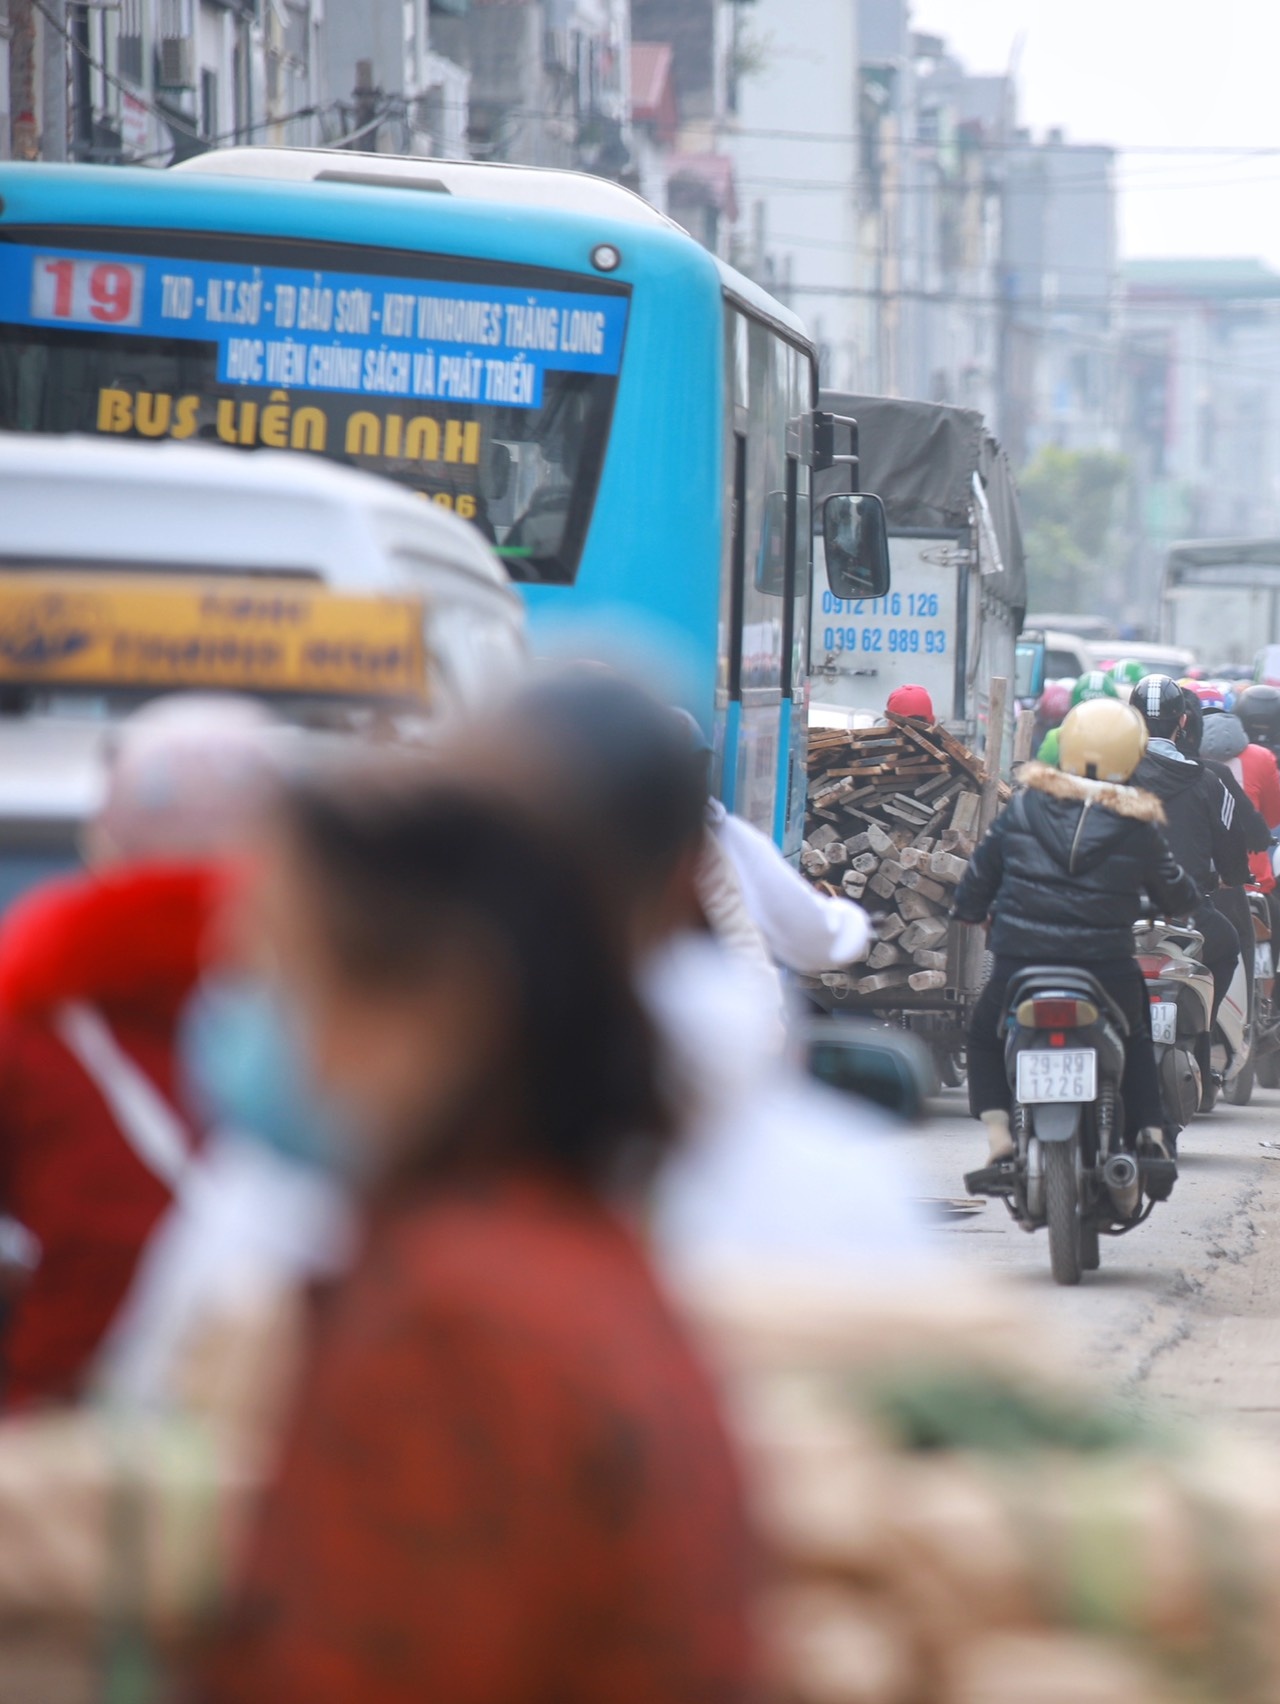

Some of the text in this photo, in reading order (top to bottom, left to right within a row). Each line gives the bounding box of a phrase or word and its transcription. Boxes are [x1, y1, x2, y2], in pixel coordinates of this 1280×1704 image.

[44, 259, 134, 324] 19
[335, 288, 373, 335] SƠN
[417, 295, 503, 347] VINHOMES
[505, 295, 560, 351] THĂNG
[560, 309, 606, 355] LONG
[226, 336, 536, 405] HỌC VIỆN CHÍNH SÁCH VÀ PHÁT TRIỂN
[96, 387, 481, 465] BUS LIÊN NINH
[822, 590, 939, 617] 0912 116 126
[824, 627, 946, 654] 039 62 989 93
